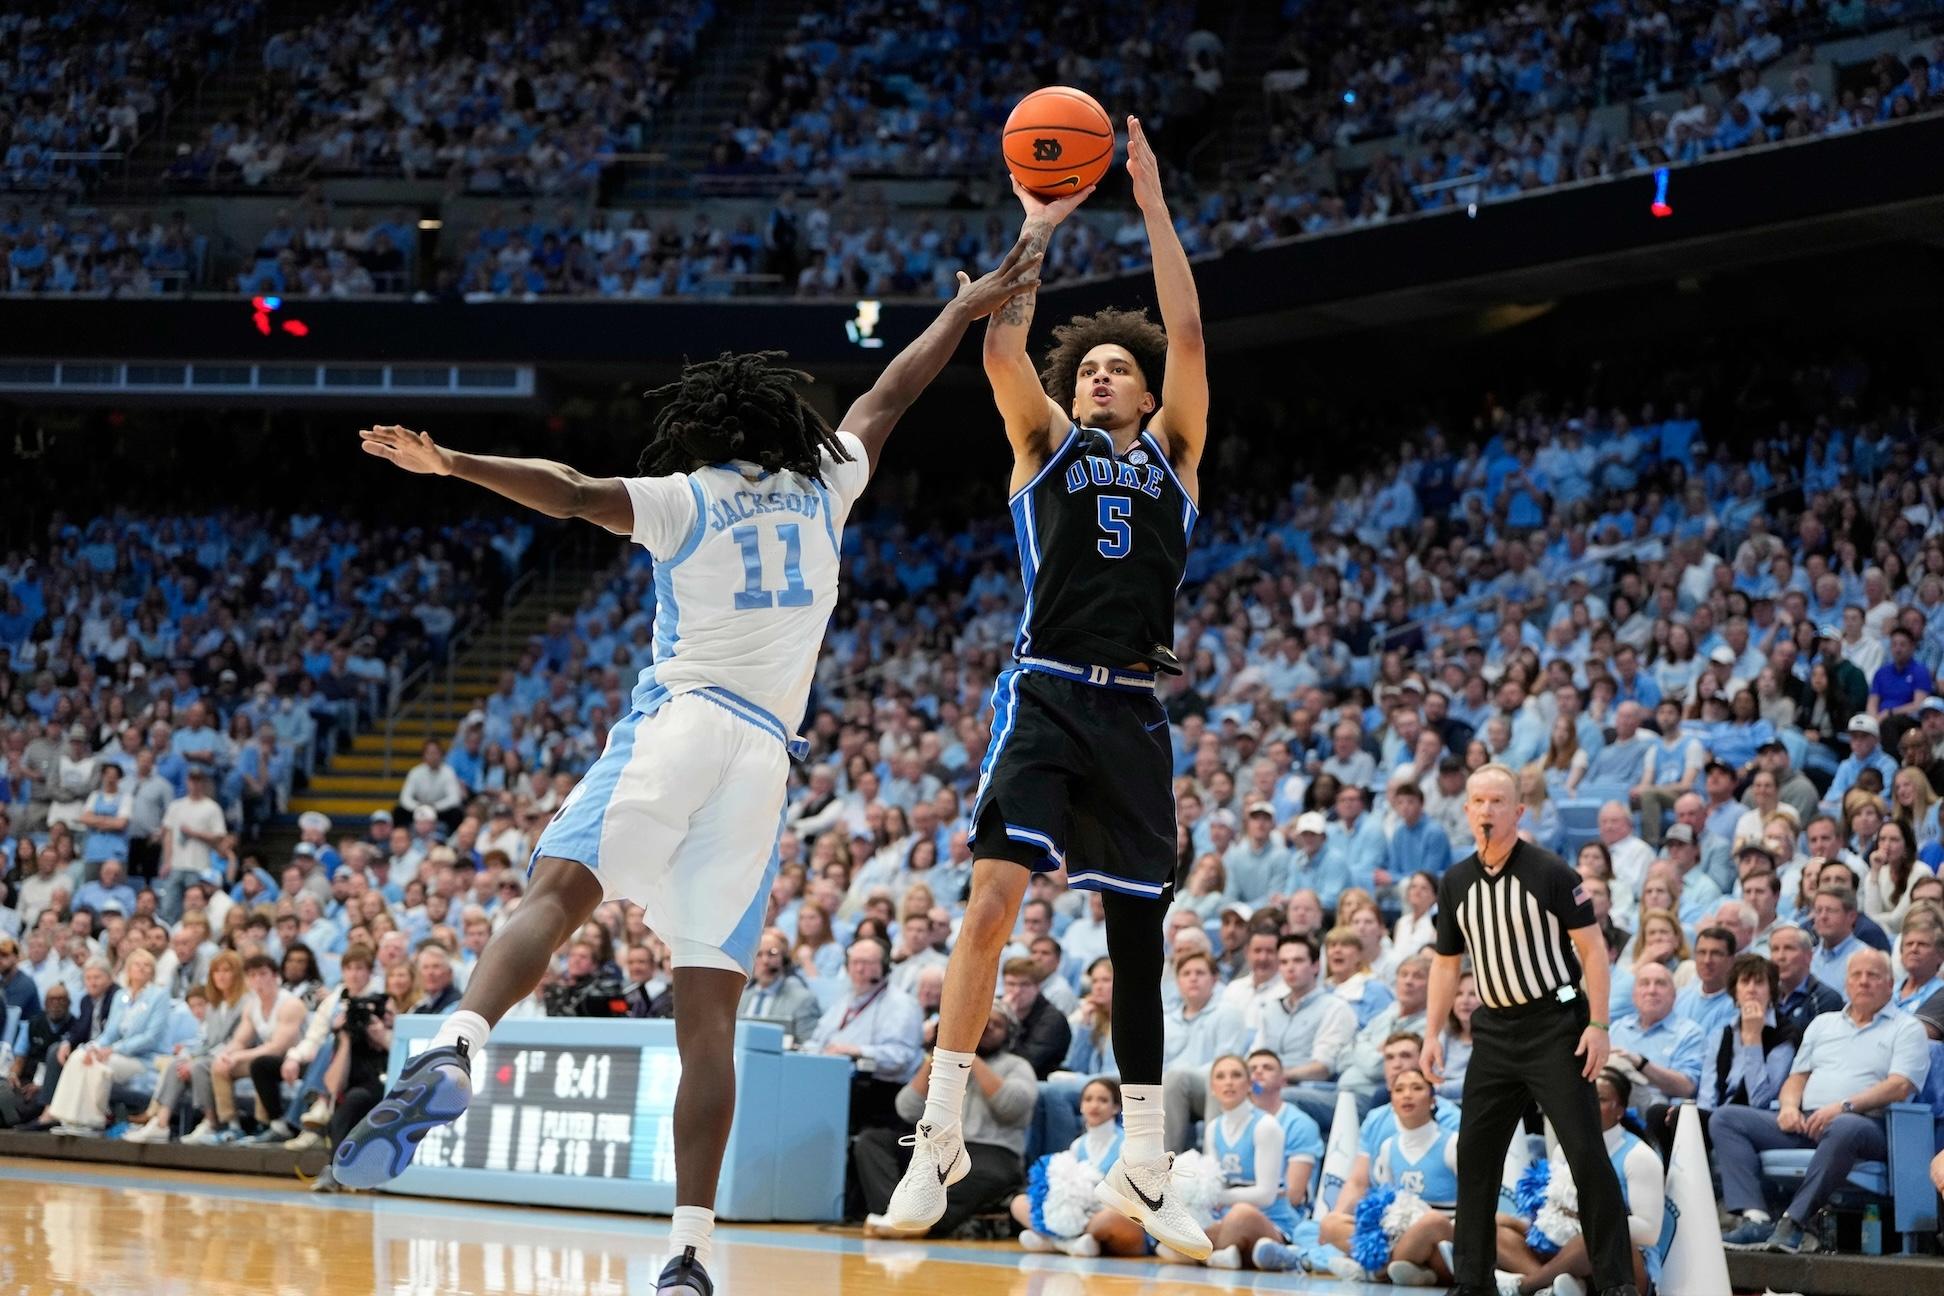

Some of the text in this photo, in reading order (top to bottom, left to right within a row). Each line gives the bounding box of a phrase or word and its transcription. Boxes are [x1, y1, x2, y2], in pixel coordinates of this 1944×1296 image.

[1066, 456, 1164, 500] DUKE
[711, 490, 820, 531] JACKSON
[1097, 495, 1132, 559] 5
[732, 523, 814, 610] 11
[1088, 664, 1110, 687] D
[554, 1052, 611, 1099] 8:41
